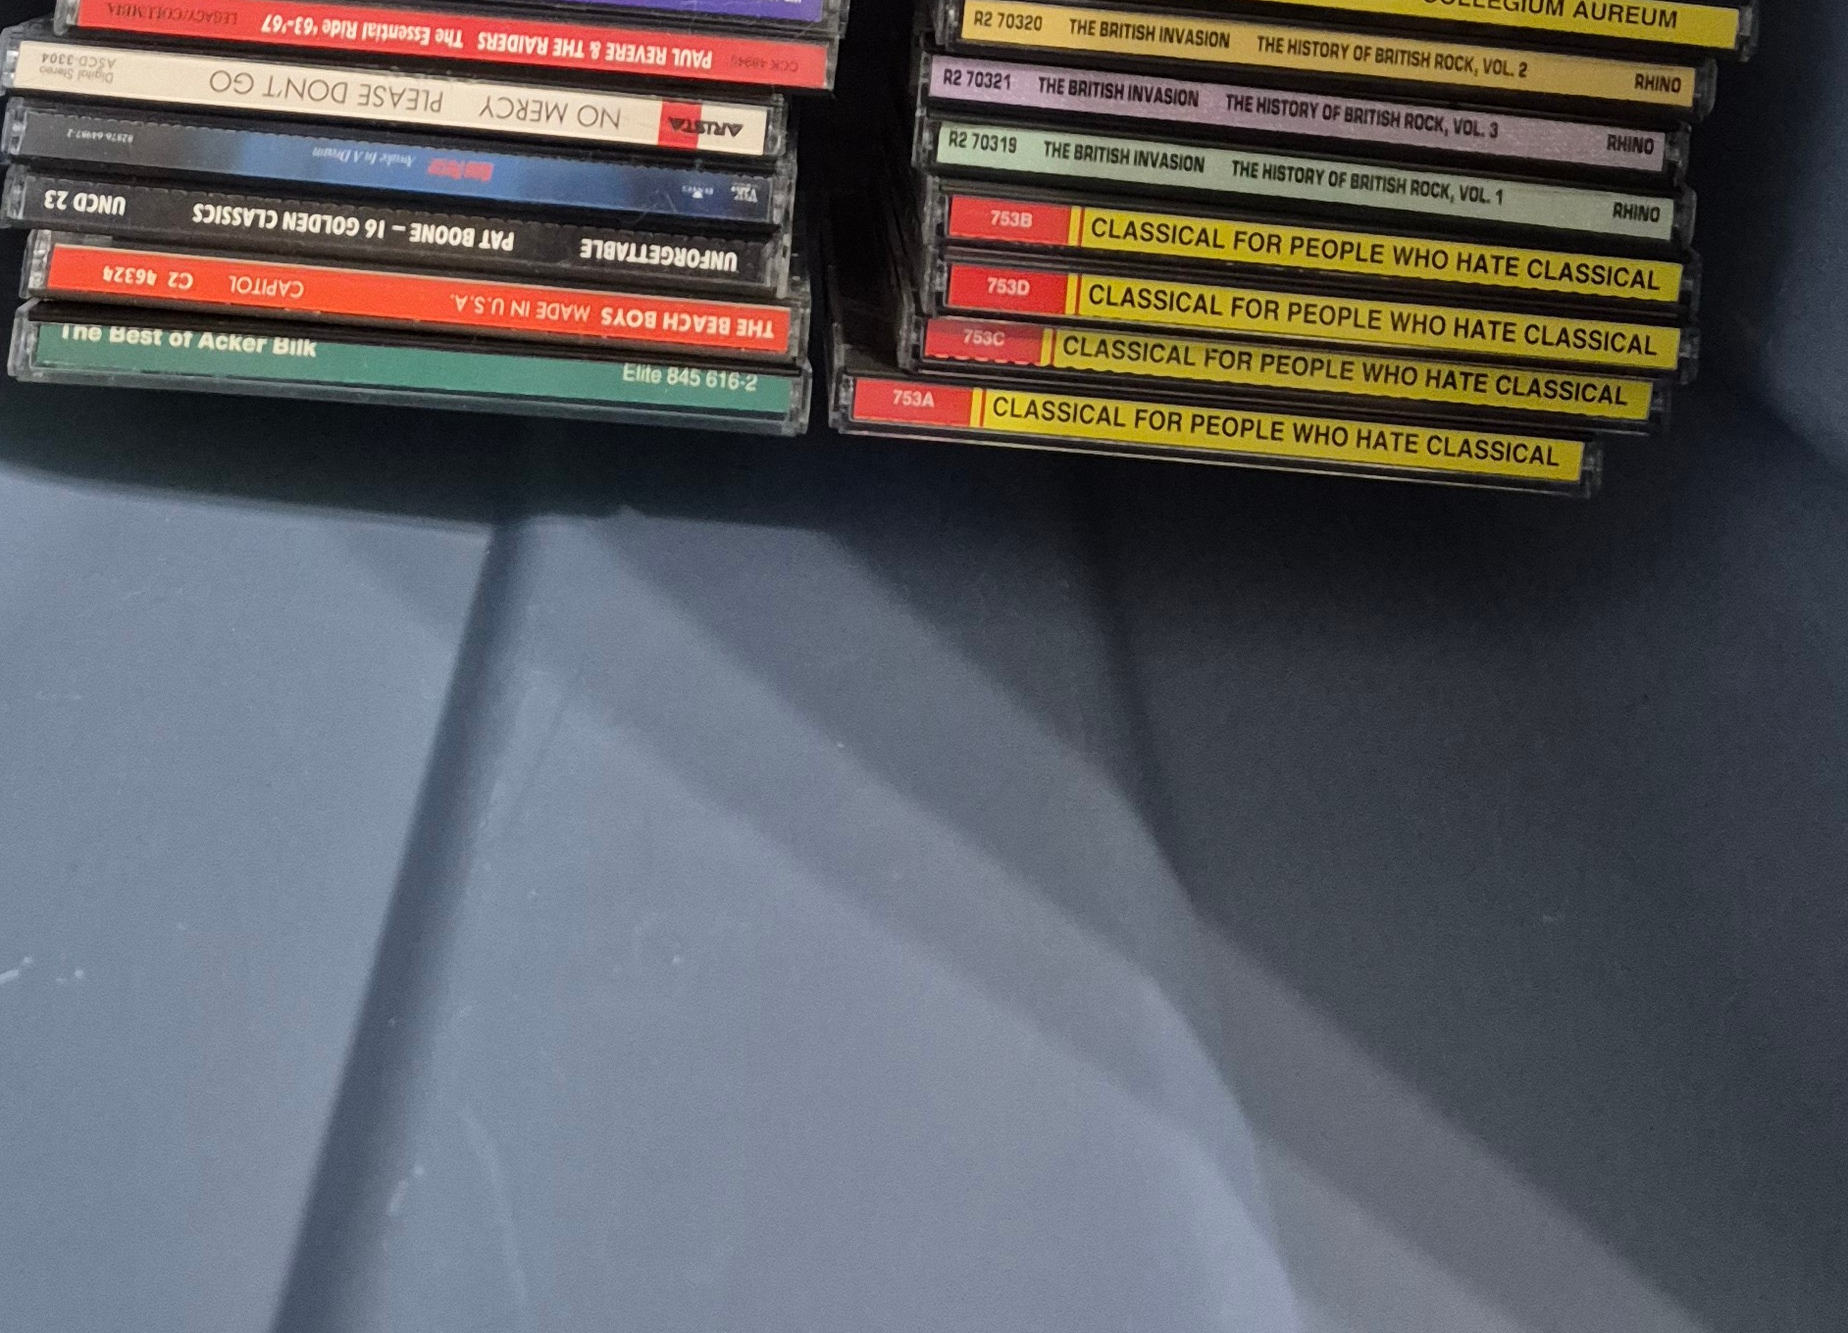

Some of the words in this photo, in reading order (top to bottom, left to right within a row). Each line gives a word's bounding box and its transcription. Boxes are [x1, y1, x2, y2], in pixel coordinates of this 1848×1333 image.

[1572, 0, 1677, 28] AUREUM
[209, 69, 254, 94] GO
[262, 75, 348, 104] DON'T
[1632, 73, 1685, 92] RHINO
[357, 83, 443, 112] PLEASE
[478, 95, 568, 124] MERCY
[576, 104, 620, 129] NO
[44, 189, 68, 209] 23
[73, 192, 127, 215] UNCD
[991, 209, 1033, 227] 753B
[579, 237, 738, 272] UNFORGETTABLE
[1091, 217, 1224, 248] CLASSICAL
[1233, 230, 1281, 254] FOR
[1289, 235, 1384, 263] PEOPLE
[1393, 245, 1448, 269] WHO
[1456, 251, 1519, 277] HATE
[1526, 258, 1659, 290] CLASSICAL
[103, 265, 156, 285] 46324
[167, 271, 193, 289] C2
[229, 275, 303, 297] CAPITOL
[987, 277, 1033, 295] 753D
[445, 294, 504, 315] U.S.A.
[510, 300, 530, 316] IN
[536, 301, 589, 321] MADE
[601, 307, 656, 328] BOYS
[662, 310, 730, 334] BEACH
[736, 318, 773, 338] THE
[893, 389, 934, 406] 753A
